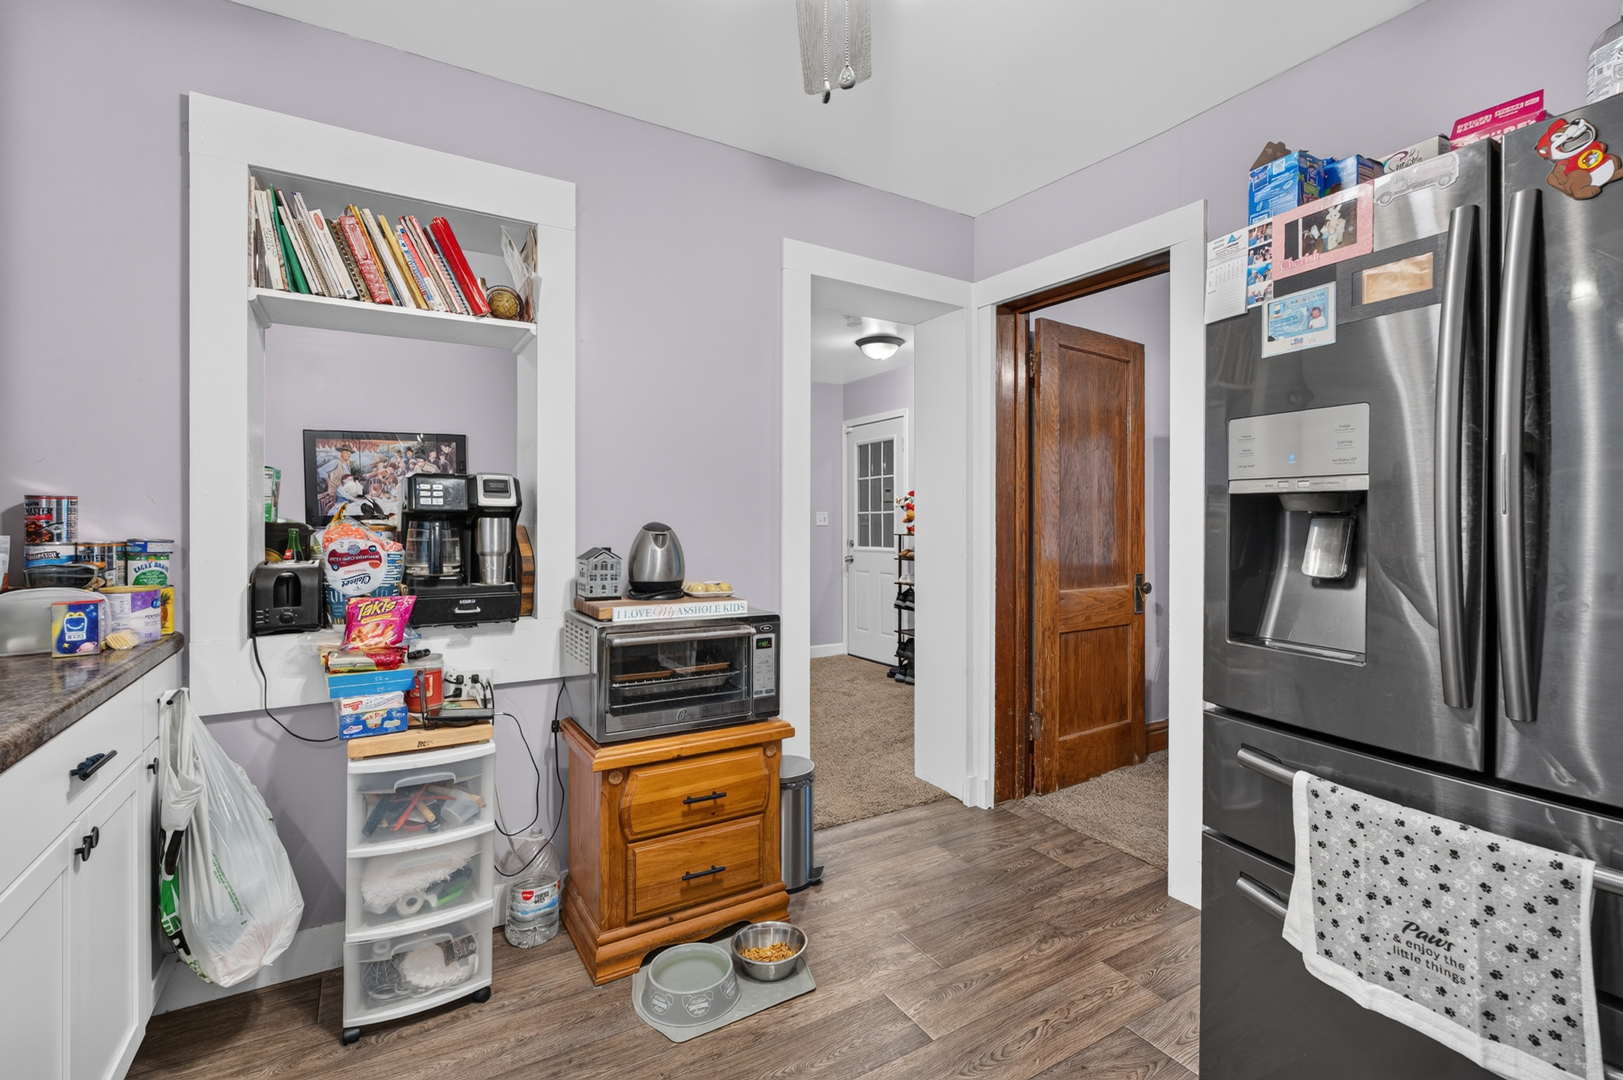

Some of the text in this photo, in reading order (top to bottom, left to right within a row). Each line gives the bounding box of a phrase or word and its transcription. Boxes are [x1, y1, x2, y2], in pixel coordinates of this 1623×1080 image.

[1280, 249, 1319, 270] Cherish
[357, 601, 396, 620] Takis
[617, 602, 746, 619] I LOVE My ASSHOLE KIDS
[1401, 920, 1456, 952] Paws
[1392, 933, 1466, 971] & enjoy the
[1393, 945, 1466, 985] little things
